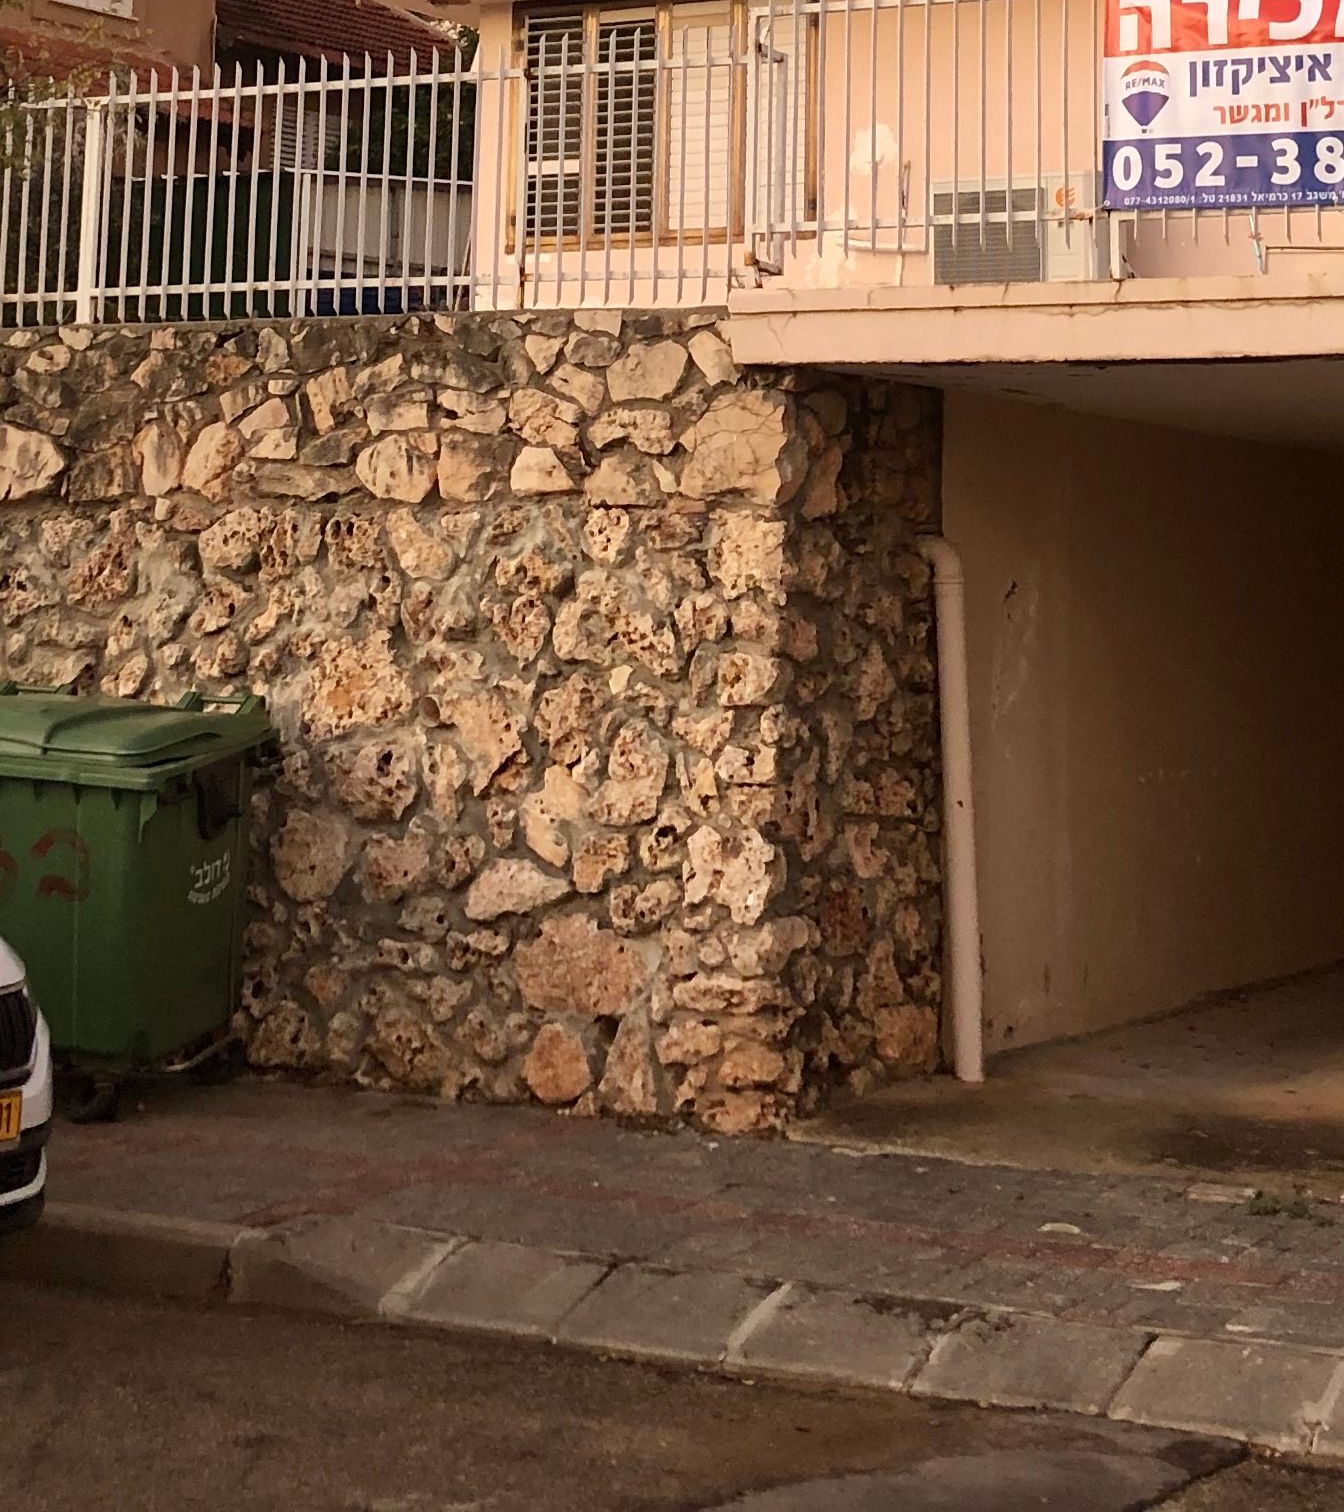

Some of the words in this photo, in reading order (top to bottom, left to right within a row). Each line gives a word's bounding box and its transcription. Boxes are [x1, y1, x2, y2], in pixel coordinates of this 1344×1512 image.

[1189, 53, 1332, 97] איציקזון
[1125, 77, 1166, 90] RE/MAX
[1213, 102, 1290, 125] ומגשר
[1218, 193, 1247, 203] 21831
[1251, 191, 1288, 202] כרמיאל
[1291, 191, 1302, 200] 17
